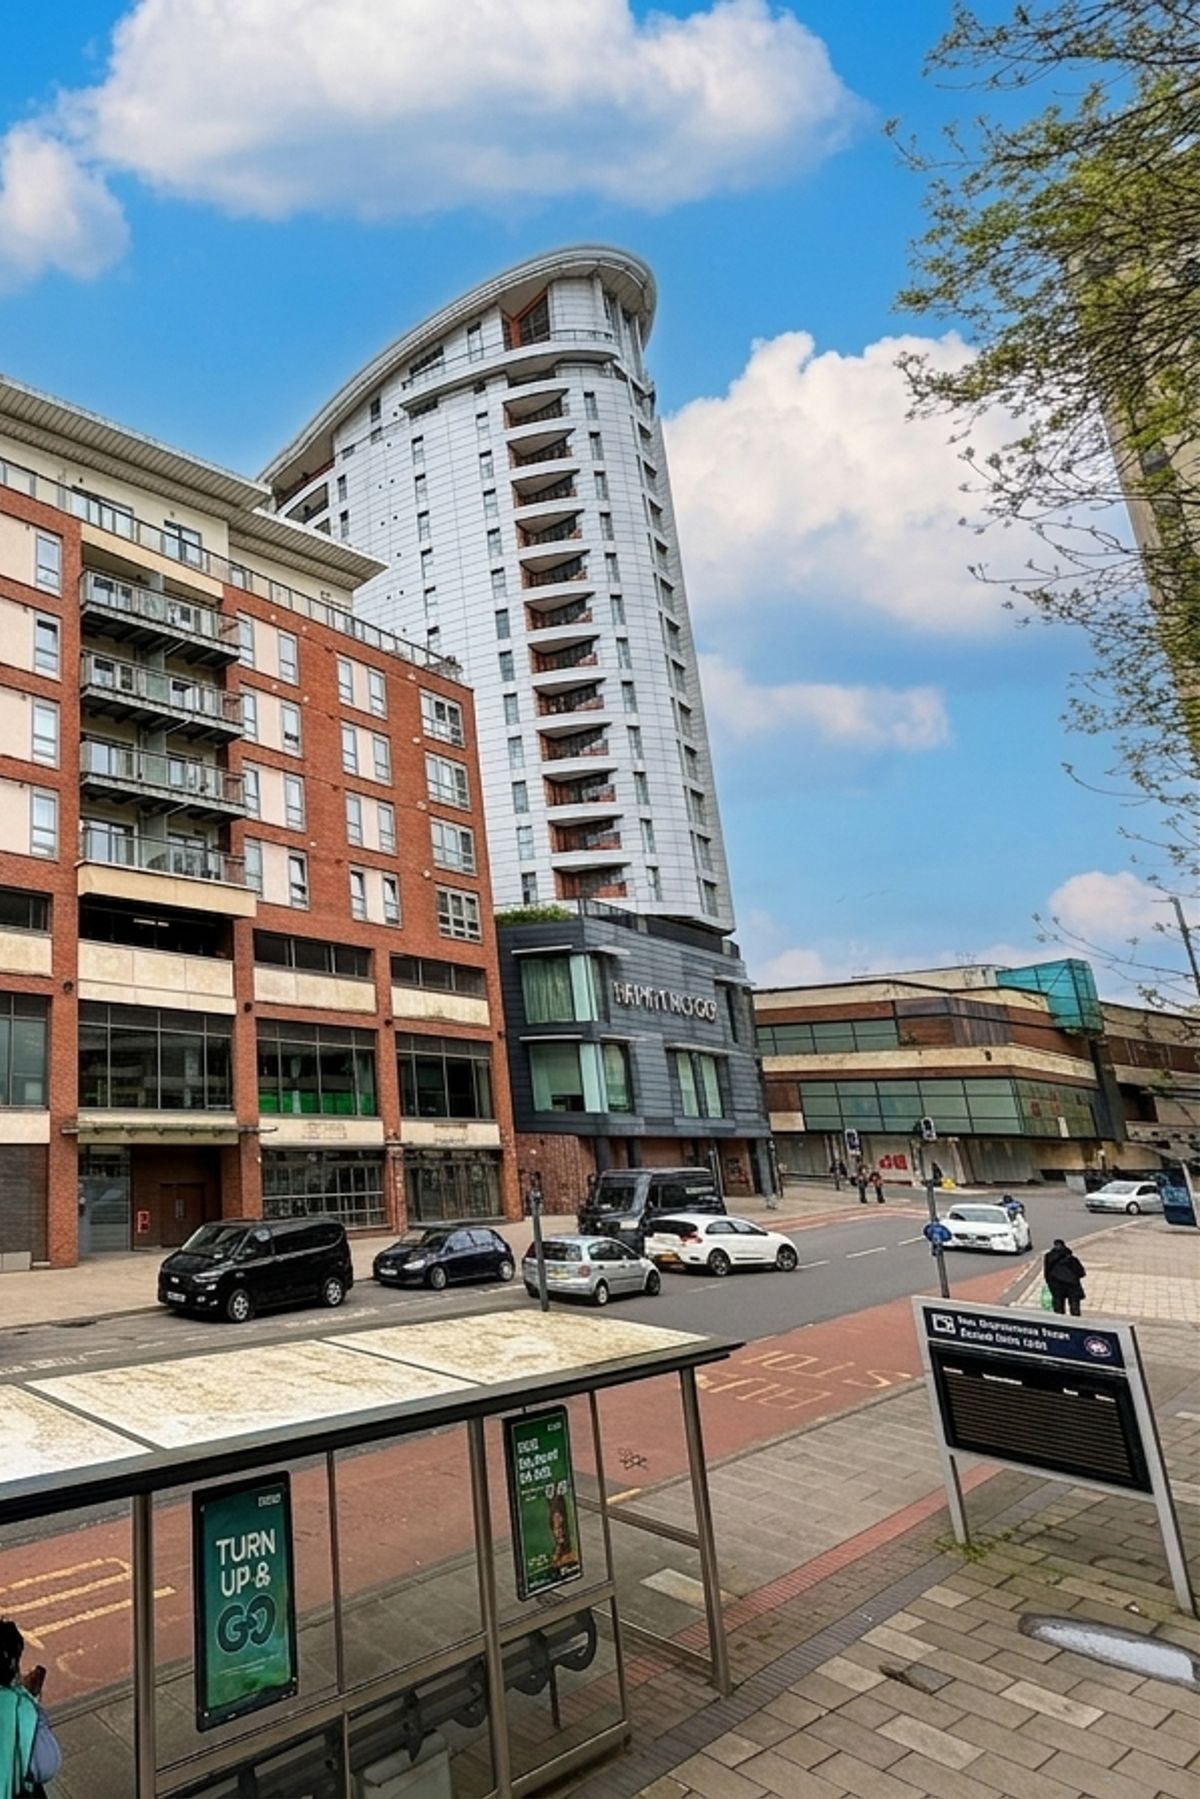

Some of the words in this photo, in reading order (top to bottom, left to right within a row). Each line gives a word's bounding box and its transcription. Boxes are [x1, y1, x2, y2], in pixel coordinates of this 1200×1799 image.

[215, 1528, 276, 1566] TURN
[220, 1564, 251, 1598] UP
[255, 1560, 271, 1589] &
[214, 1592, 277, 1656] GO
